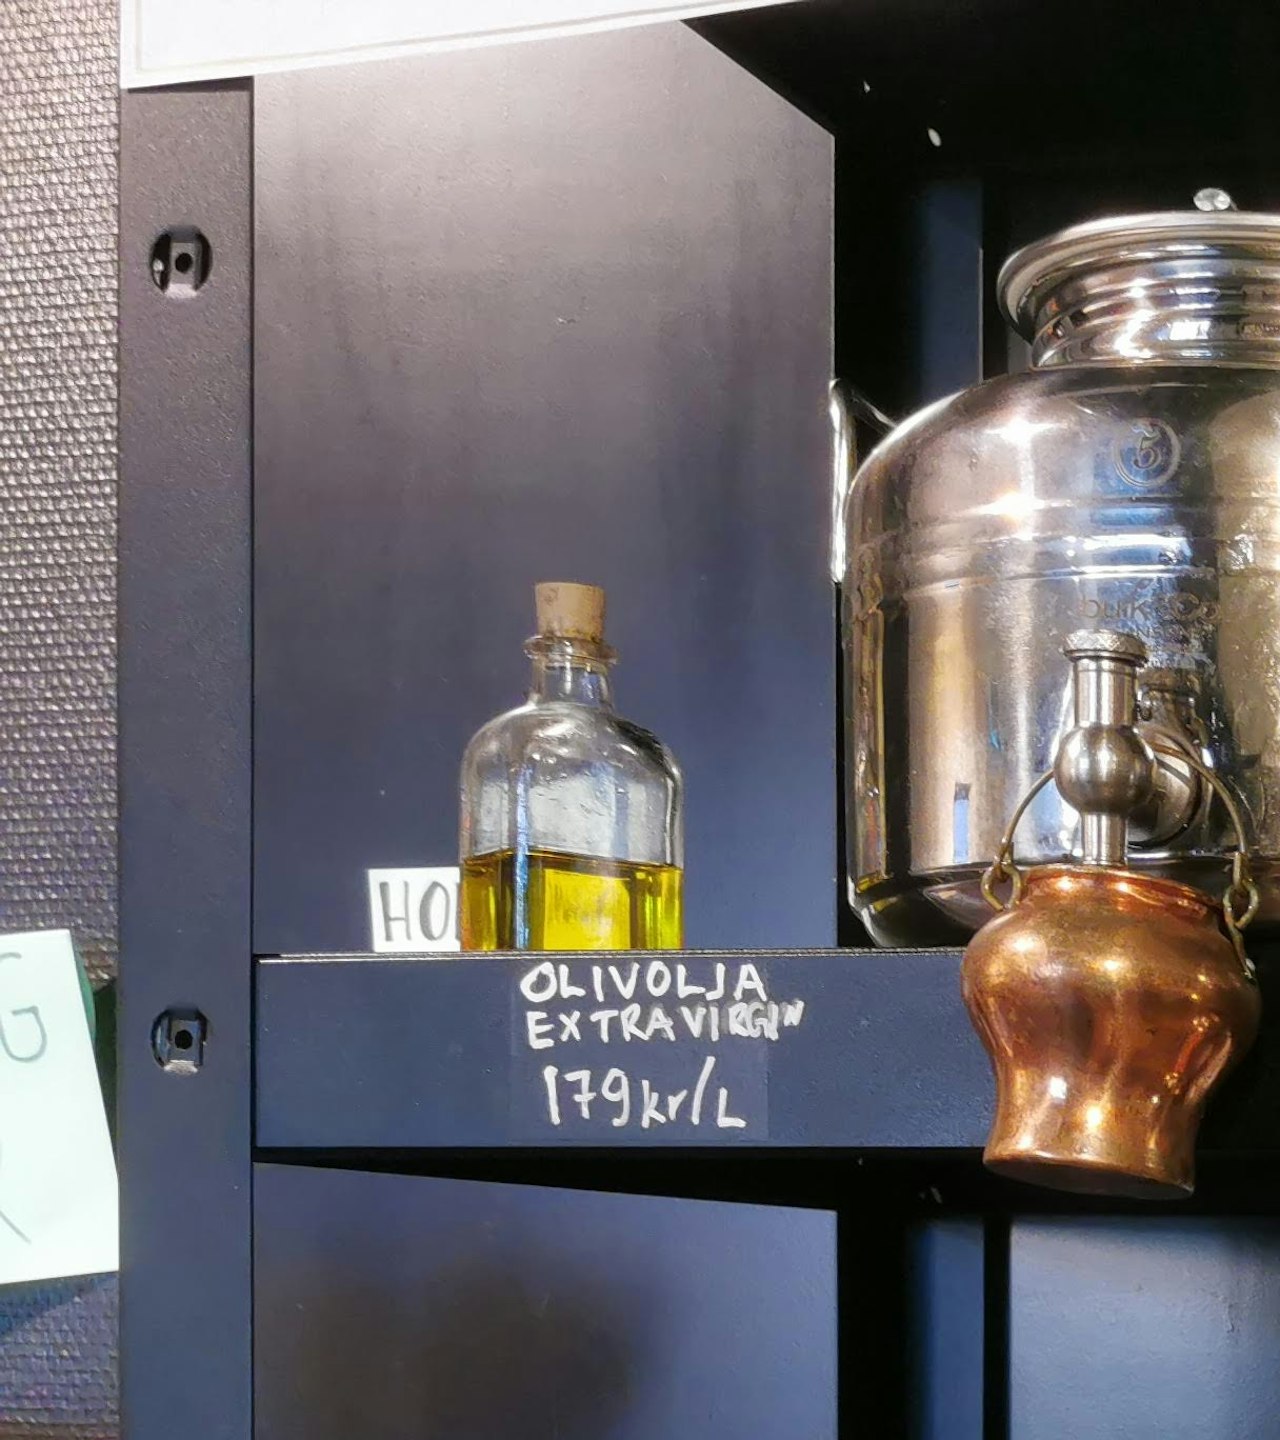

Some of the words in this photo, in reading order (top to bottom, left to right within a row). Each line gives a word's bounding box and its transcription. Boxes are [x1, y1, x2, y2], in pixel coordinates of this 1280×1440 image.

[380, 879, 461, 942] HO
[519, 961, 768, 1003] OLIVOLJA
[543, 1055, 747, 1128] 179kr/L
